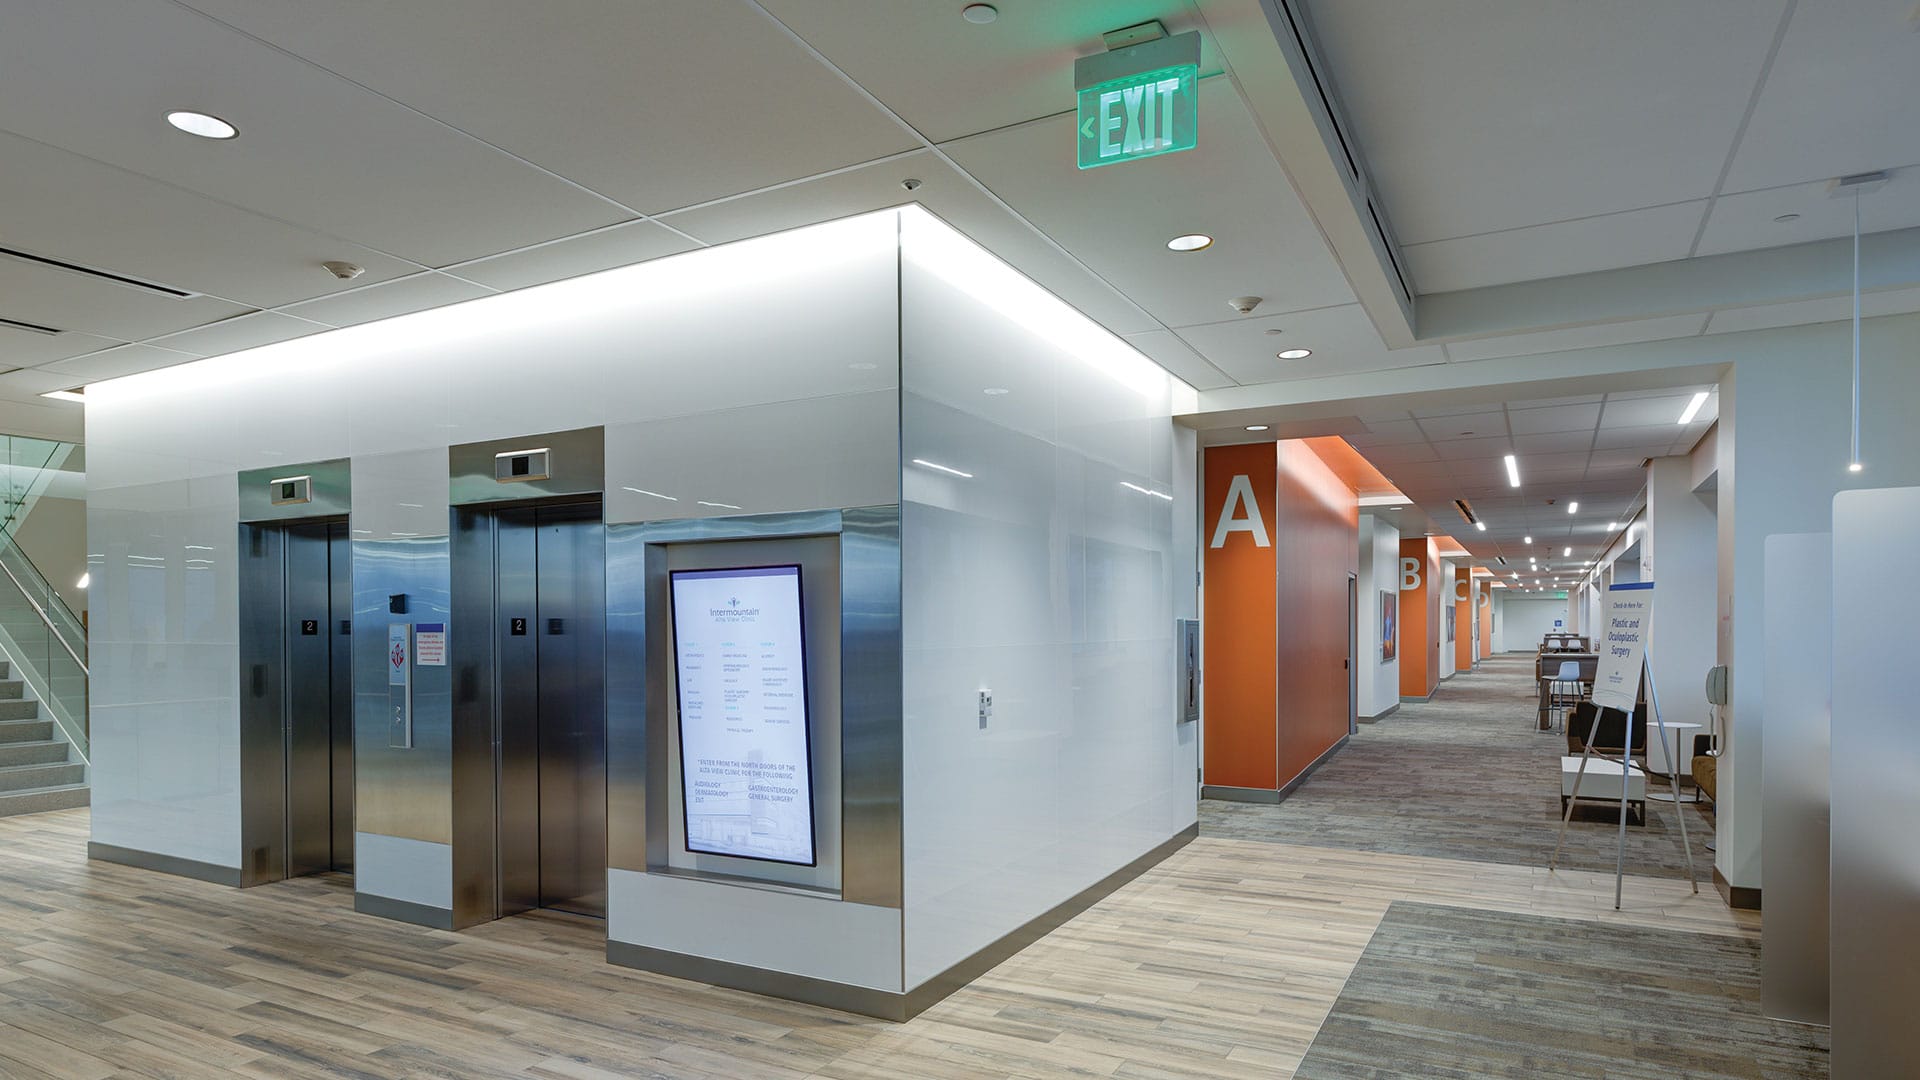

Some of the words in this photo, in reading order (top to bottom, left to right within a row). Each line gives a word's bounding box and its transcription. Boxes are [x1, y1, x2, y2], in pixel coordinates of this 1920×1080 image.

[1100, 77, 1179, 157] EXIT
[1210, 475, 1271, 549] A
[1400, 557, 1421, 591] B
[1455, 579, 1467, 602] C
[710, 608, 760, 617] Intermountain
[307, 621, 313, 631] 2
[516, 619, 522, 631] 2
[1611, 618, 1629, 628] Plastic
[1629, 618, 1640, 628] and
[1608, 631, 1639, 644] Oculoplastic
[1610, 645, 1631, 658] Surgery
[741, 761, 759, 769] NORTH
[759, 762, 777, 770] DOORS
[724, 768, 741, 776] CLINIC
[694, 788, 729, 797] DERMATOLOGY
[748, 784, 799, 795] GASTROENTEROLOGY
[748, 792, 770, 802] GENERAL
[771, 795, 794, 803] SURGERY
